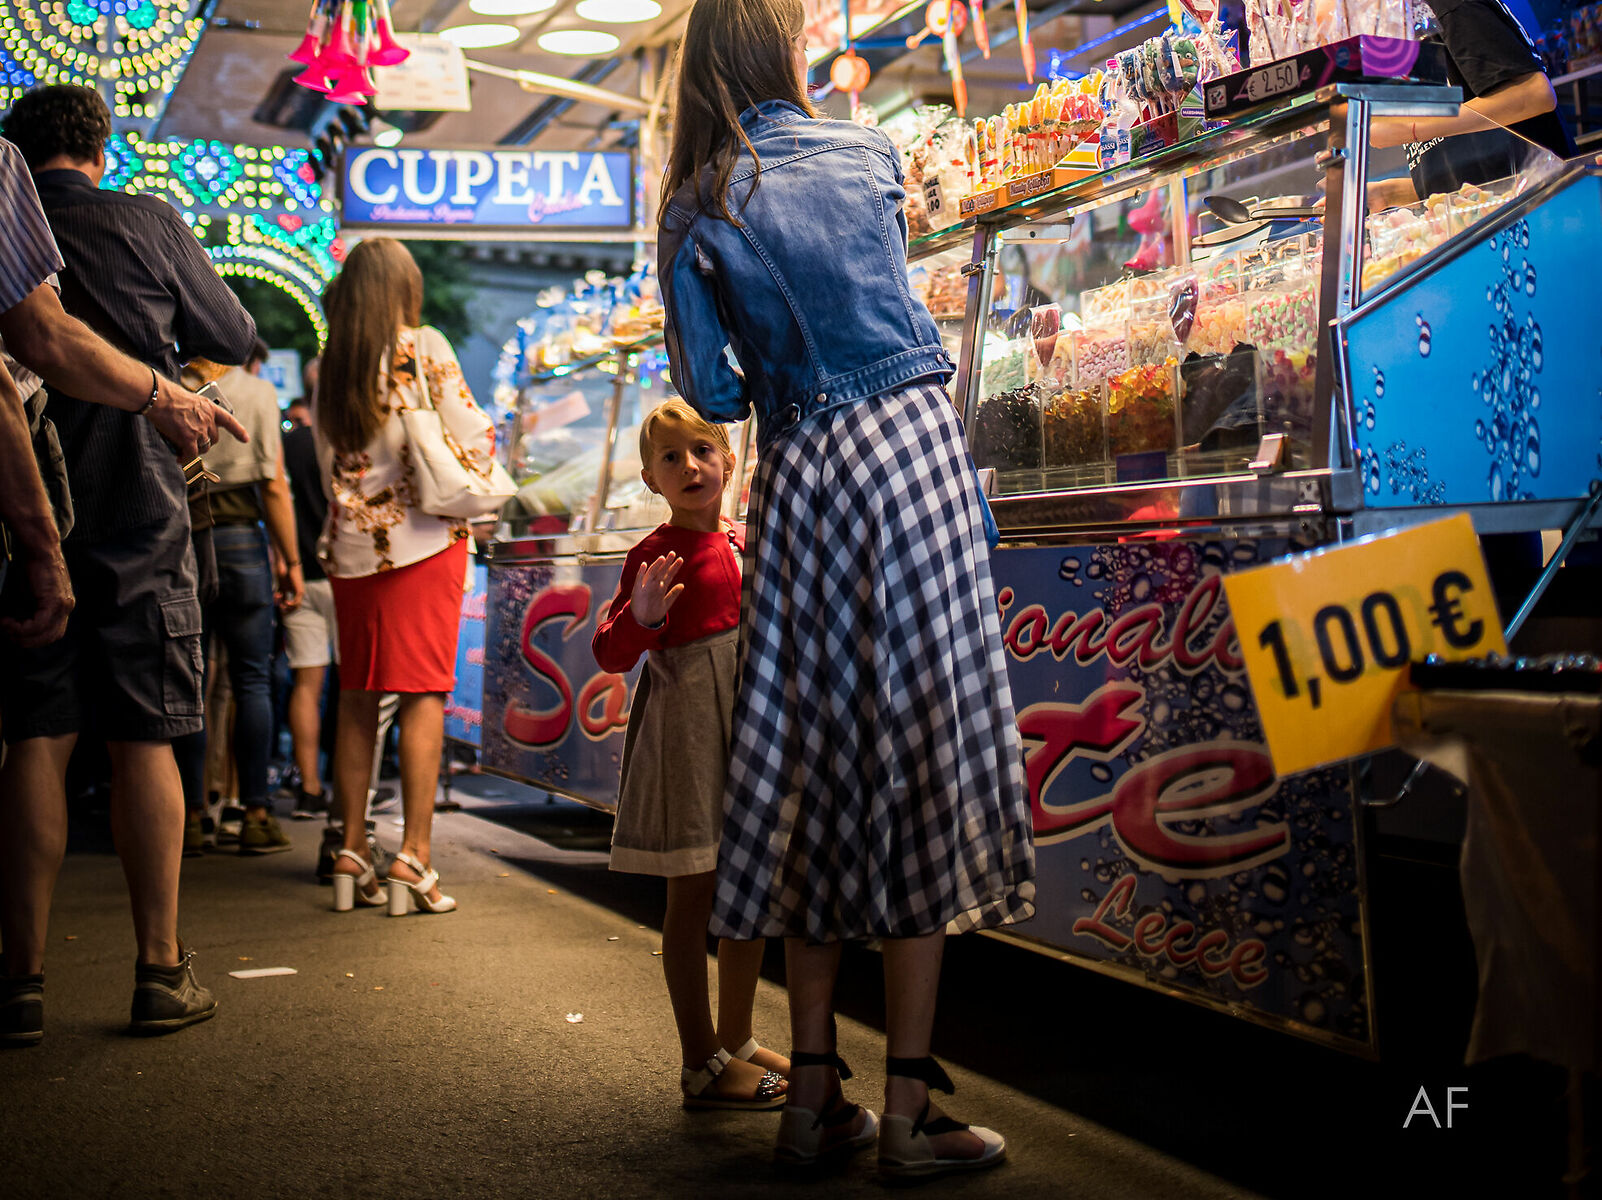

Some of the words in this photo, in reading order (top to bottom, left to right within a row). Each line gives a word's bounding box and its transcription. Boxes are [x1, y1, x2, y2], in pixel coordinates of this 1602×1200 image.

[1262, 64, 1293, 94] 2,50
[350, 148, 624, 206] CUPETA
[1257, 591, 1410, 709] 1,00
[1430, 569, 1484, 649] €
[1072, 873, 1268, 990] Lecce
